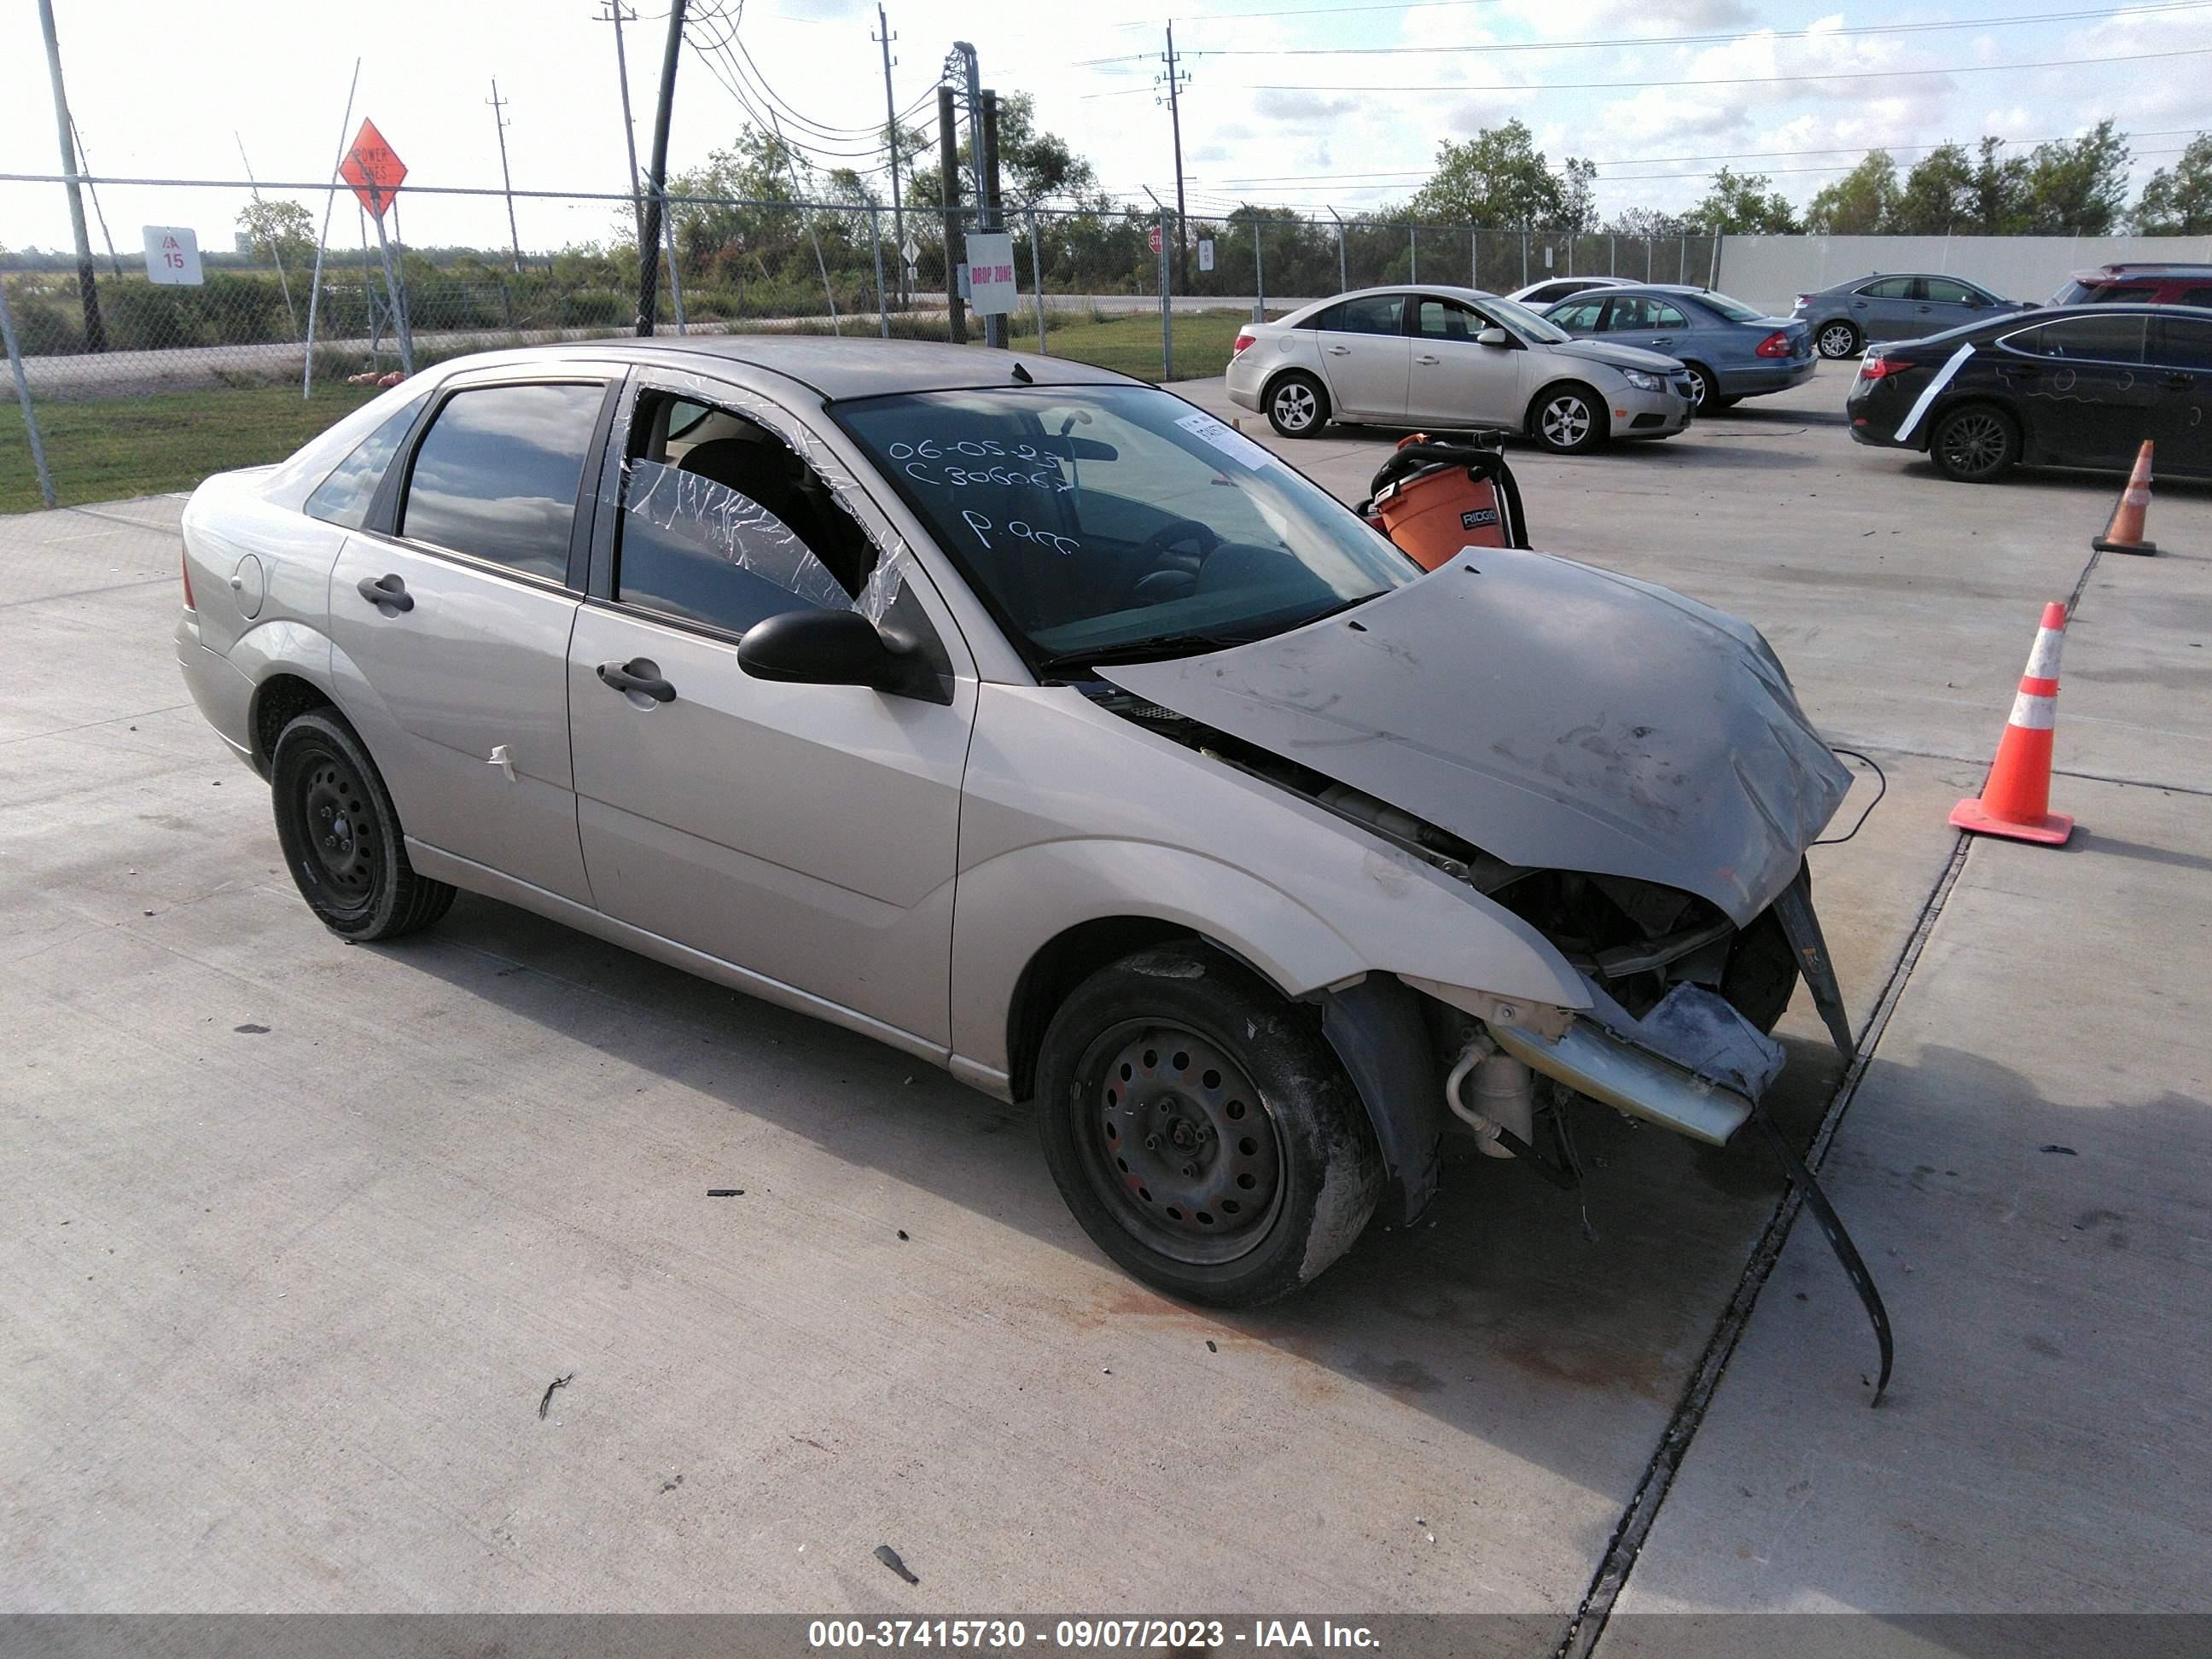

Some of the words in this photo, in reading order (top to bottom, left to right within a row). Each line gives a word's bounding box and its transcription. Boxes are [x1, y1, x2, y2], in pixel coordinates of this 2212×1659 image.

[164, 253, 184, 268] 15
[972, 266, 992, 284] DROP
[995, 265, 1012, 282] ZONE
[1463, 511, 1496, 525] RIDGID
